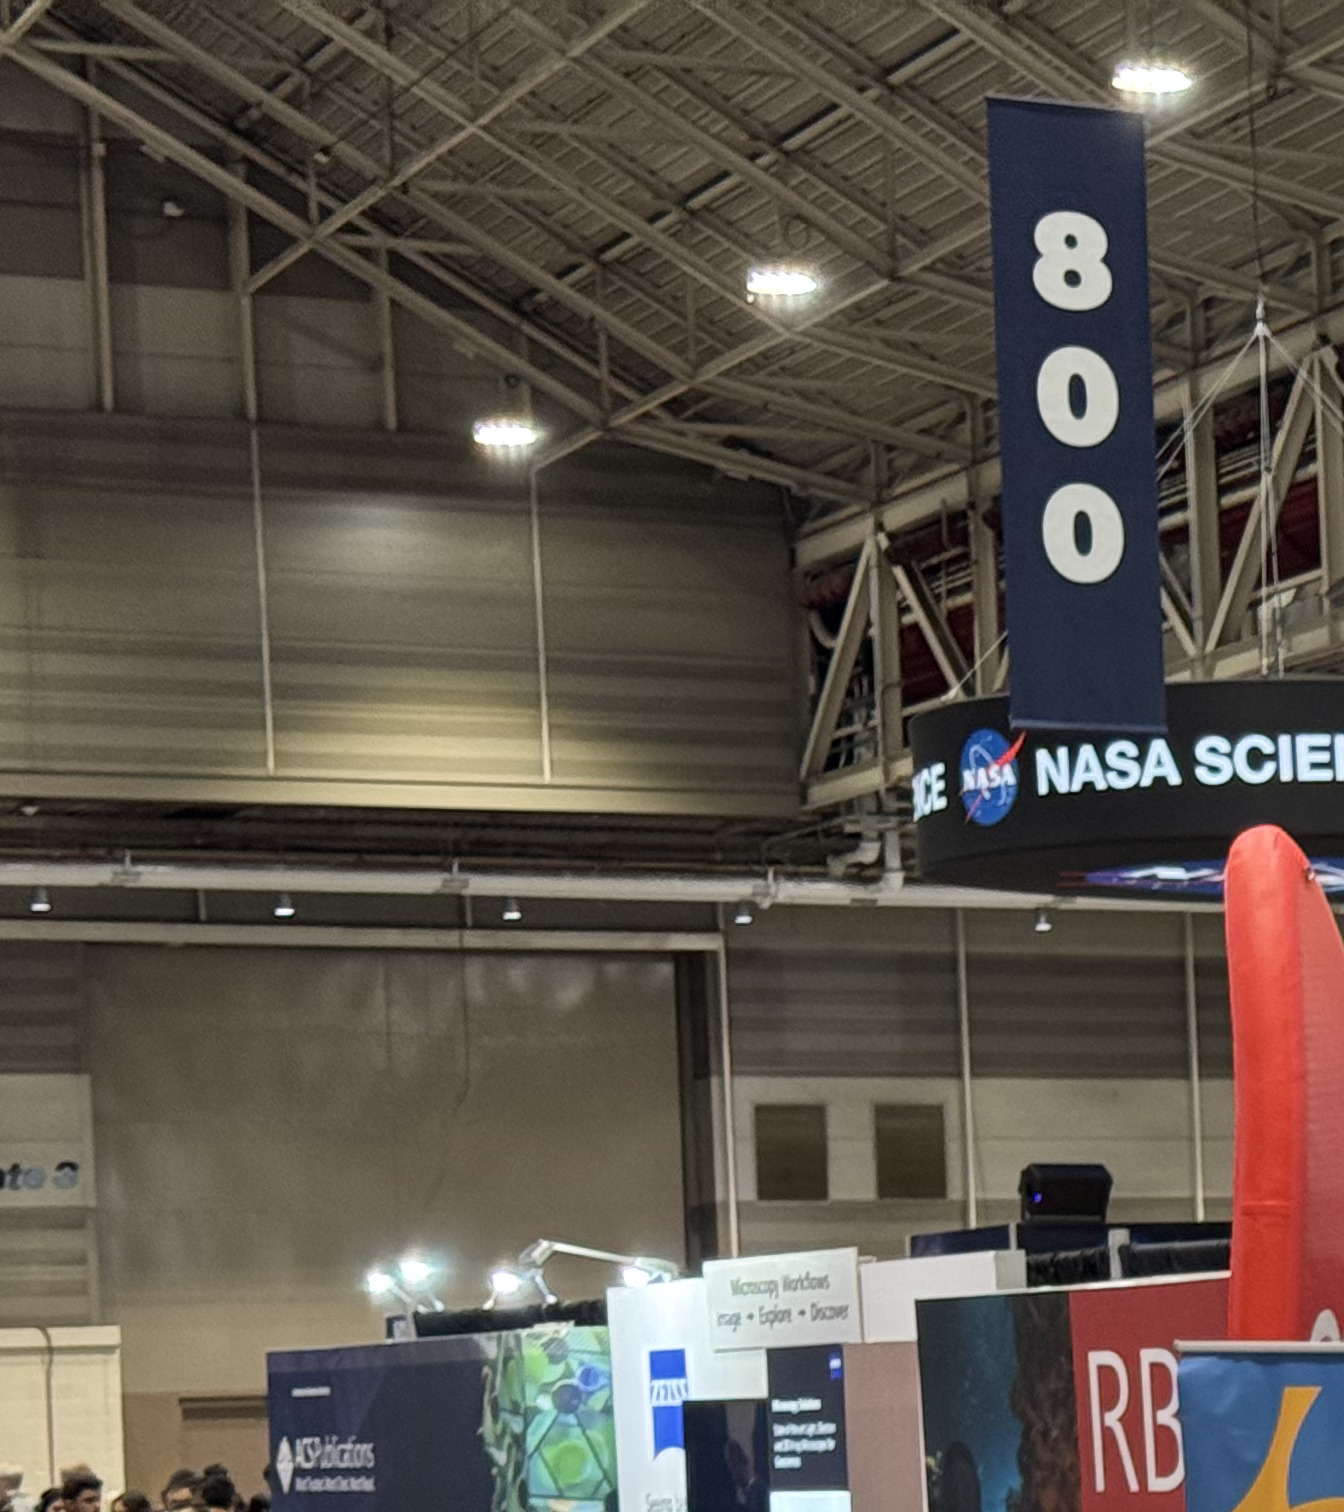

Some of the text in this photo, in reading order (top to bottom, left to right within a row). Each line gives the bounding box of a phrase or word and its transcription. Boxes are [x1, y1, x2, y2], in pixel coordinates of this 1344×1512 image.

[1033, 211, 1124, 584] 800
[1035, 738, 1183, 798] NASA
[1088, 1347, 1187, 1494] RB
